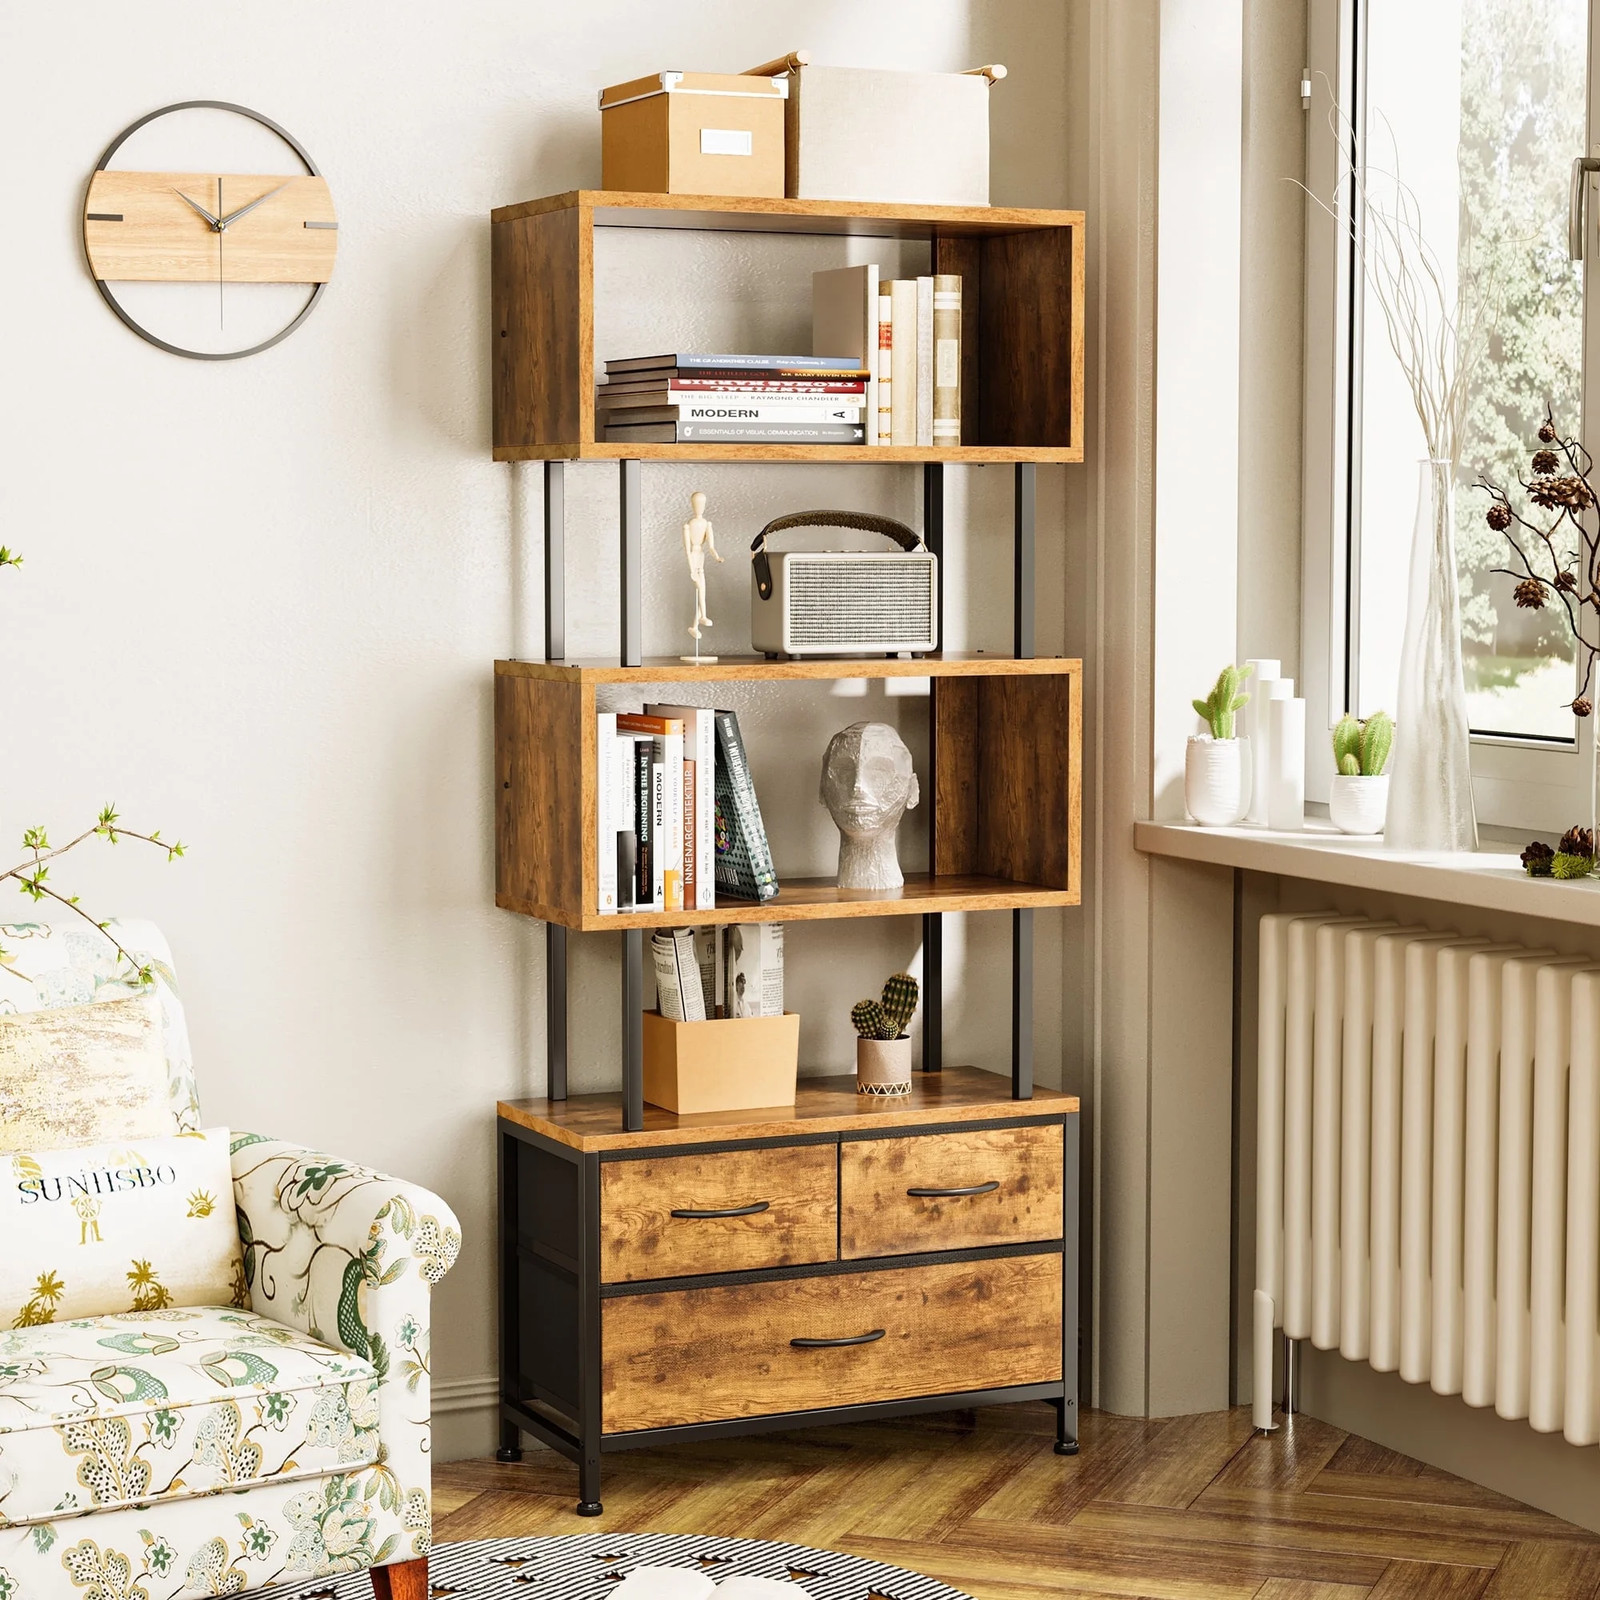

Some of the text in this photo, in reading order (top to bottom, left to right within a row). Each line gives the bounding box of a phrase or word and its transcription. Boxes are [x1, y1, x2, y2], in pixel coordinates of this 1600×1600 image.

[690, 408, 760, 418] MODERN
[832, 411, 846, 419] A
[641, 756, 648, 768] IN
[684, 769, 694, 885] INNENARCHITEKTUR
[656, 886, 663, 896] A
